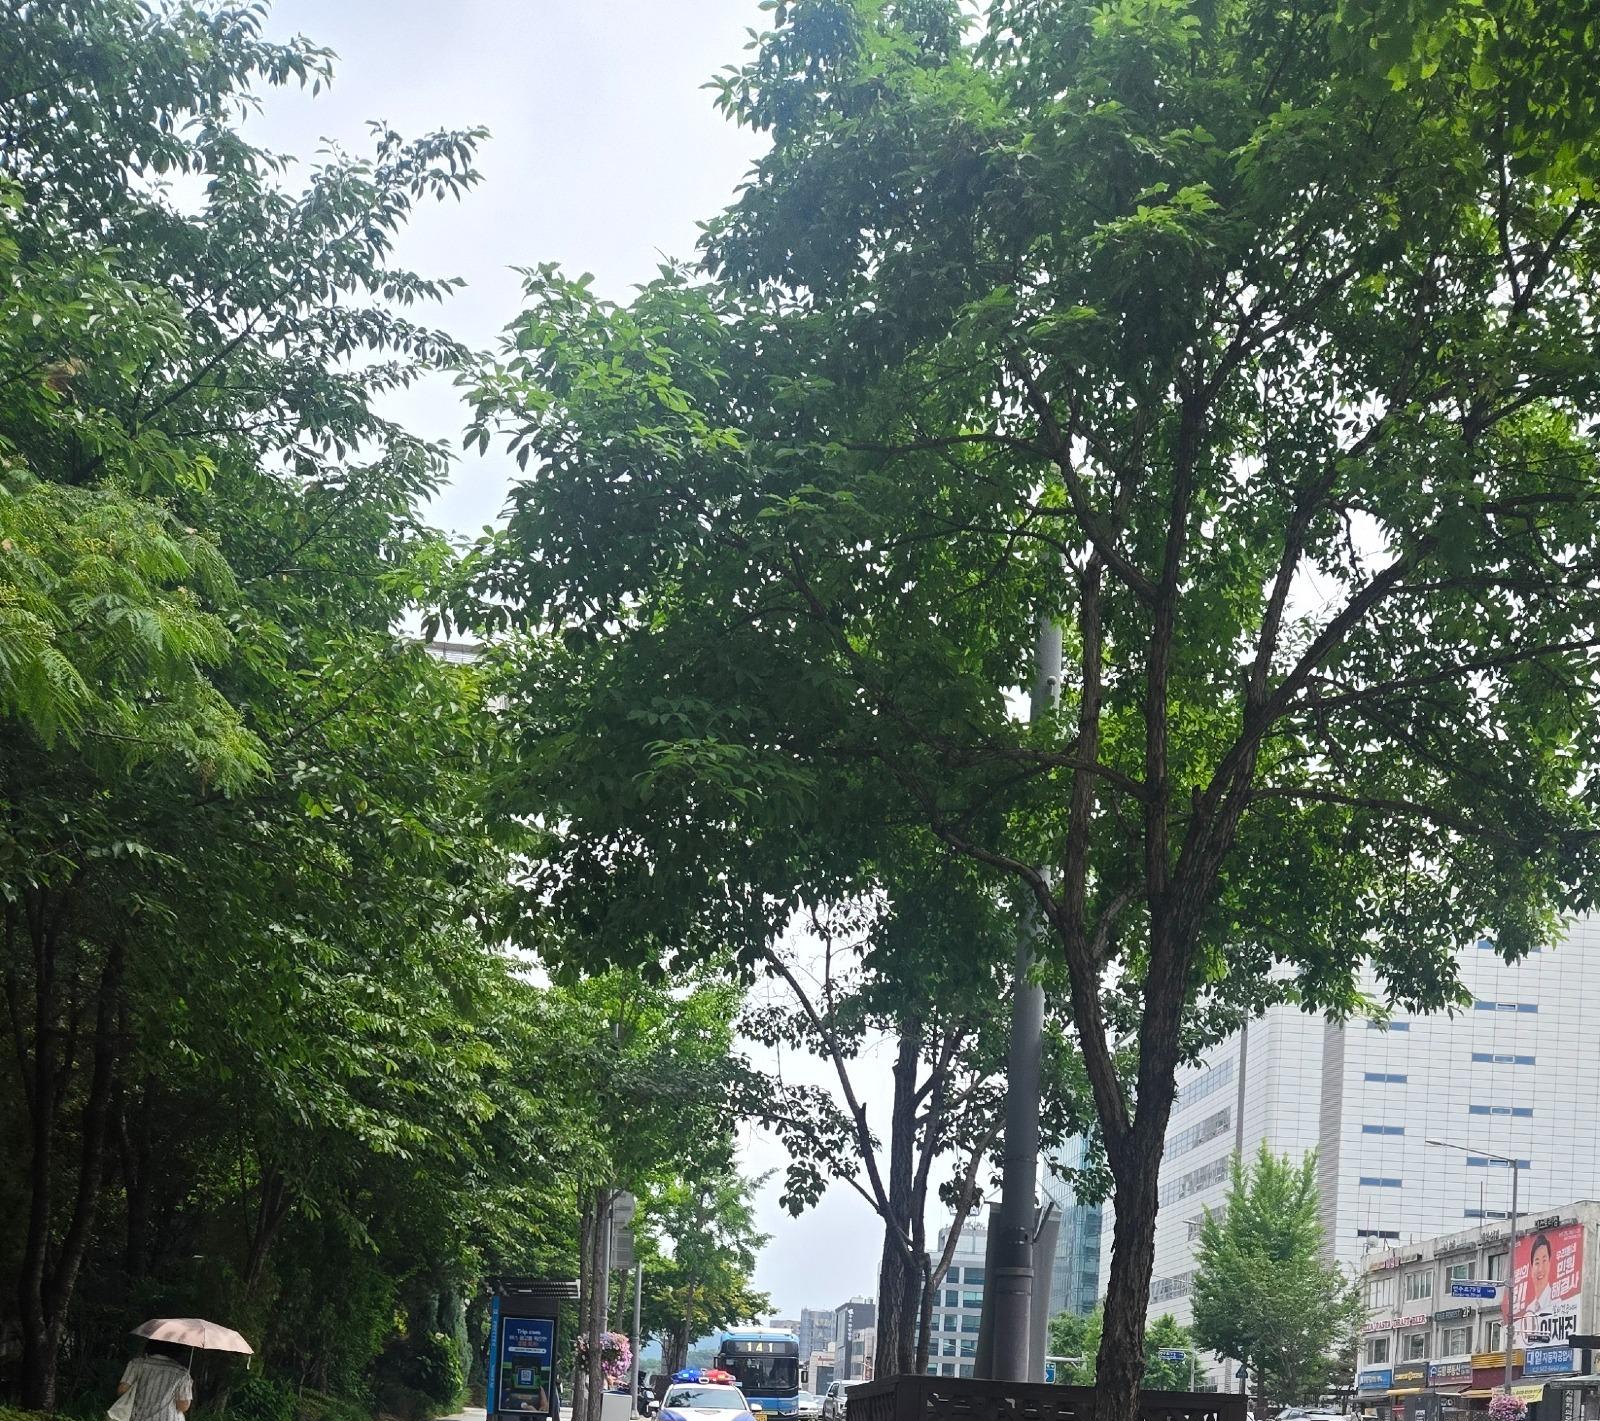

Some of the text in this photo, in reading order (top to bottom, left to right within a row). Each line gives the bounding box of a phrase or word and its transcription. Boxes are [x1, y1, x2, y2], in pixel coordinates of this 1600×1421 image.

[1557, 1254, 1576, 1279] 민원
[1551, 1271, 1580, 1299] 해결사
[746, 1341, 774, 1353] 141
[1526, 1348, 1573, 1366] 대일 자동차공업사
